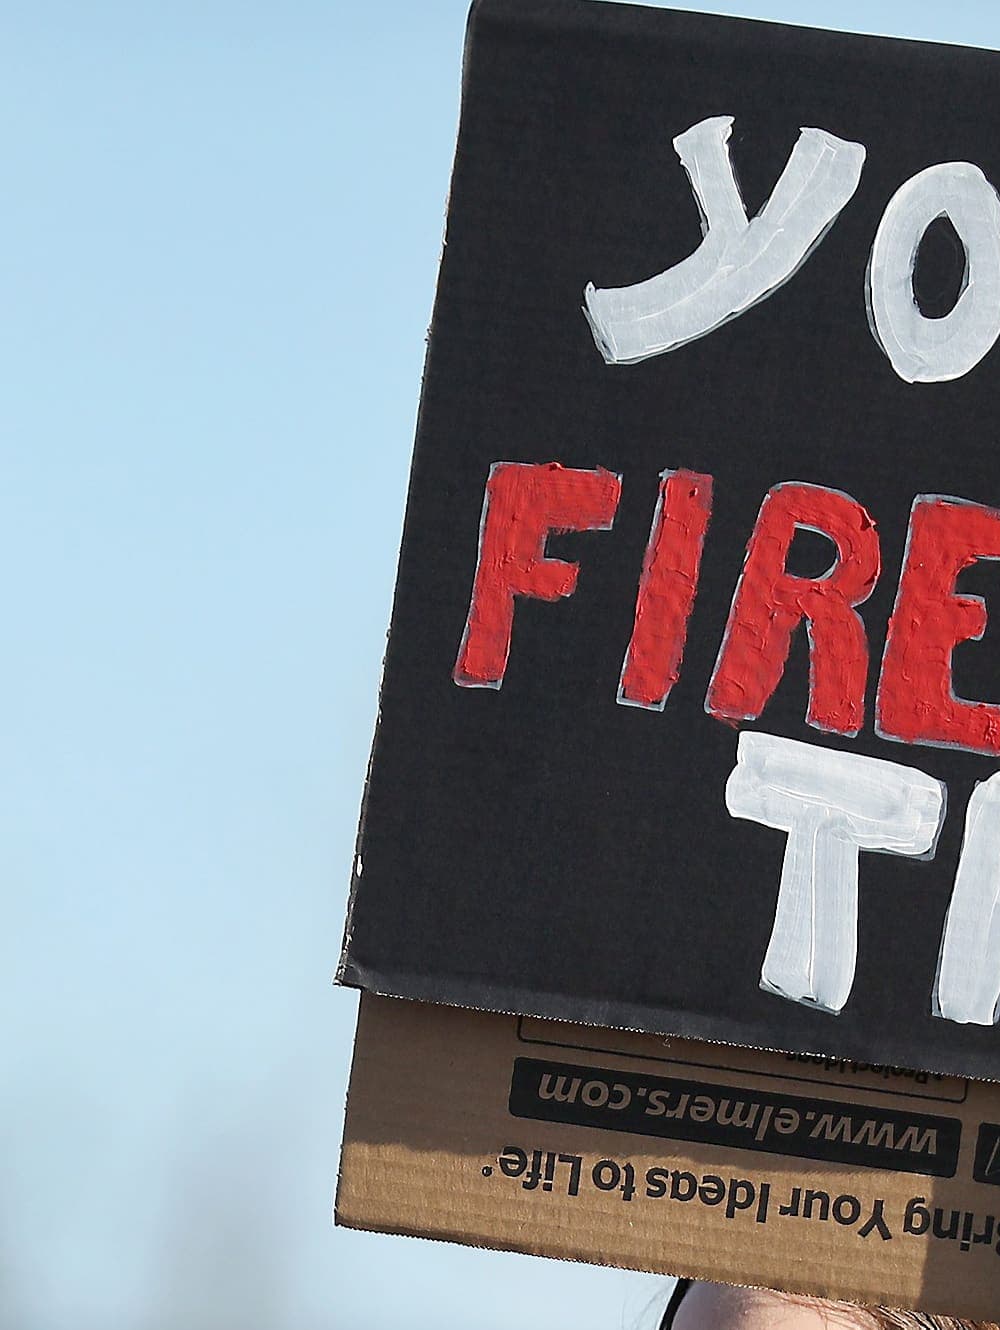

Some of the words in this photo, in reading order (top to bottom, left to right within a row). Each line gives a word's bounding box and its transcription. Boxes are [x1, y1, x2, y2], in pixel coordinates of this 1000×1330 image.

[537, 1072, 937, 1155] www.elmers.com
[591, 1158, 636, 1201] to
[645, 1166, 771, 1223] Ideas
[778, 1187, 893, 1241] Your
